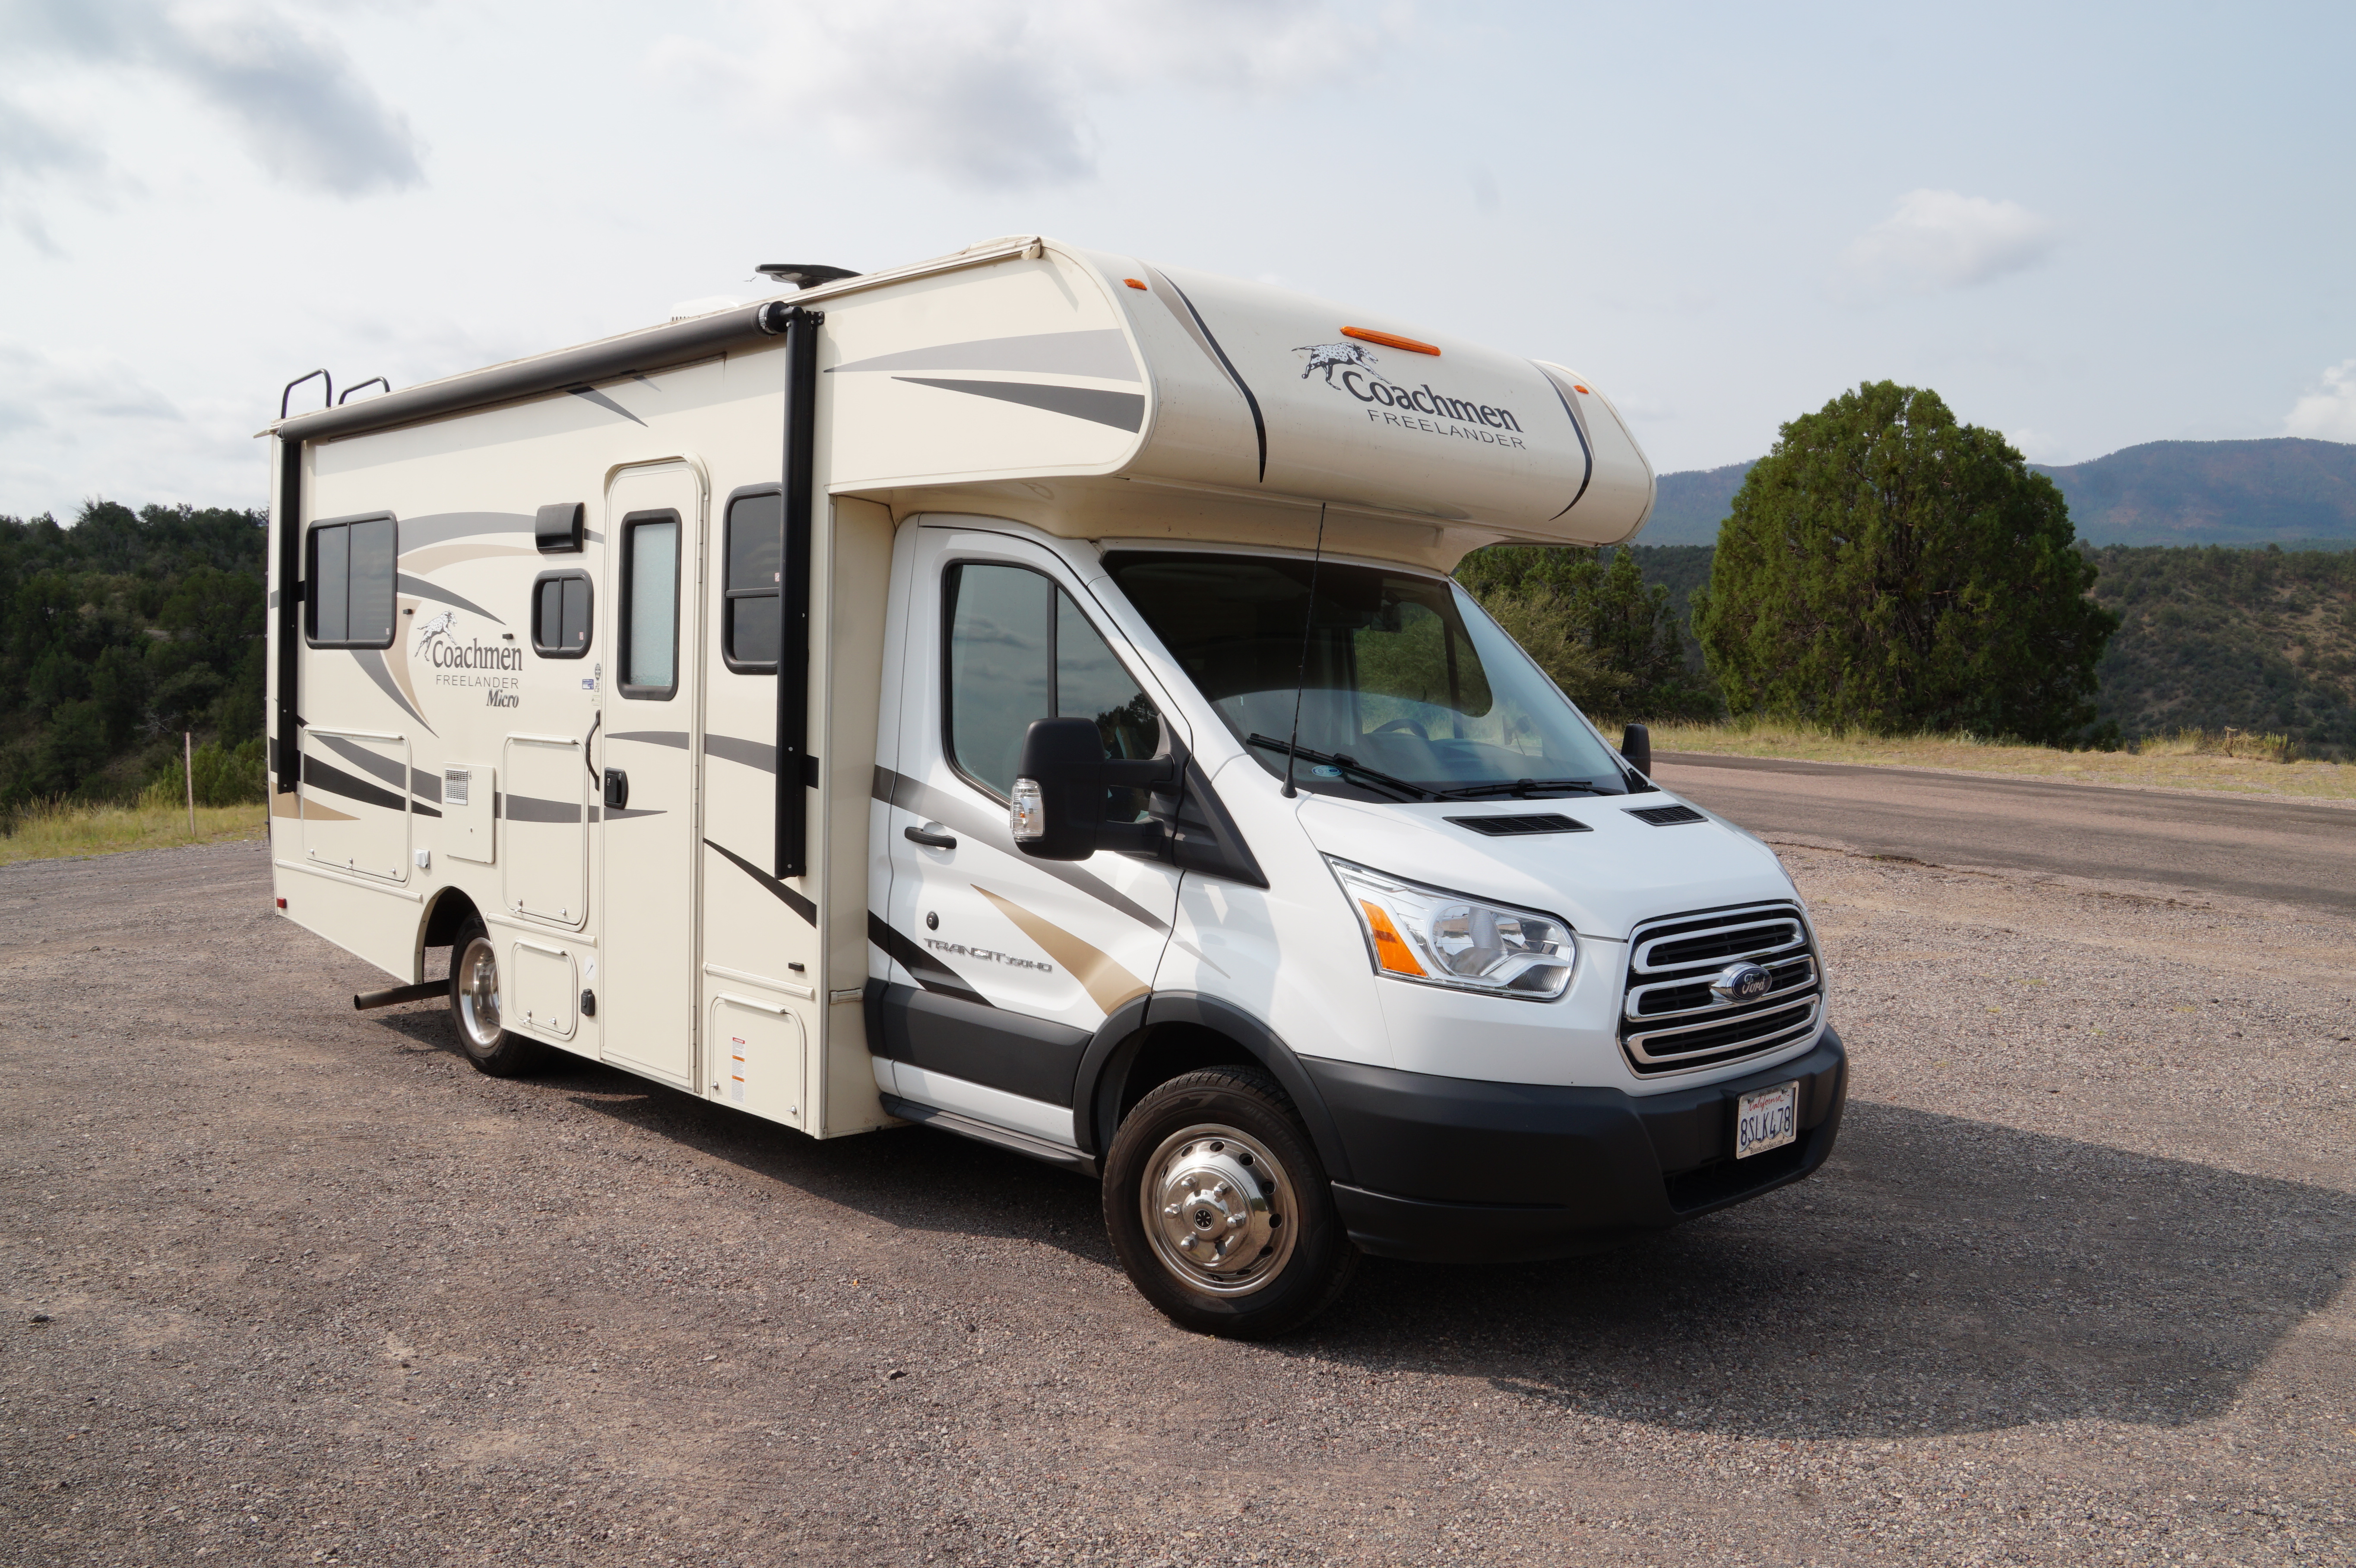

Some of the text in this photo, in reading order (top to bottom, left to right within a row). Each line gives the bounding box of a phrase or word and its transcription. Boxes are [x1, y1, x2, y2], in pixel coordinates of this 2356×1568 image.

[1342, 370, 1523, 433] Coachmen
[1367, 409, 1526, 450] FREELANDER
[433, 638, 522, 671] Coachmen
[436, 675, 519, 689] FREELANDER
[486, 689, 519, 708] Micro
[924, 938, 1006, 962] TRANSIT
[1742, 973, 1766, 994] Ford
[1748, 1095, 1784, 1112] California
[1740, 1106, 1791, 1146] 8SLK478
